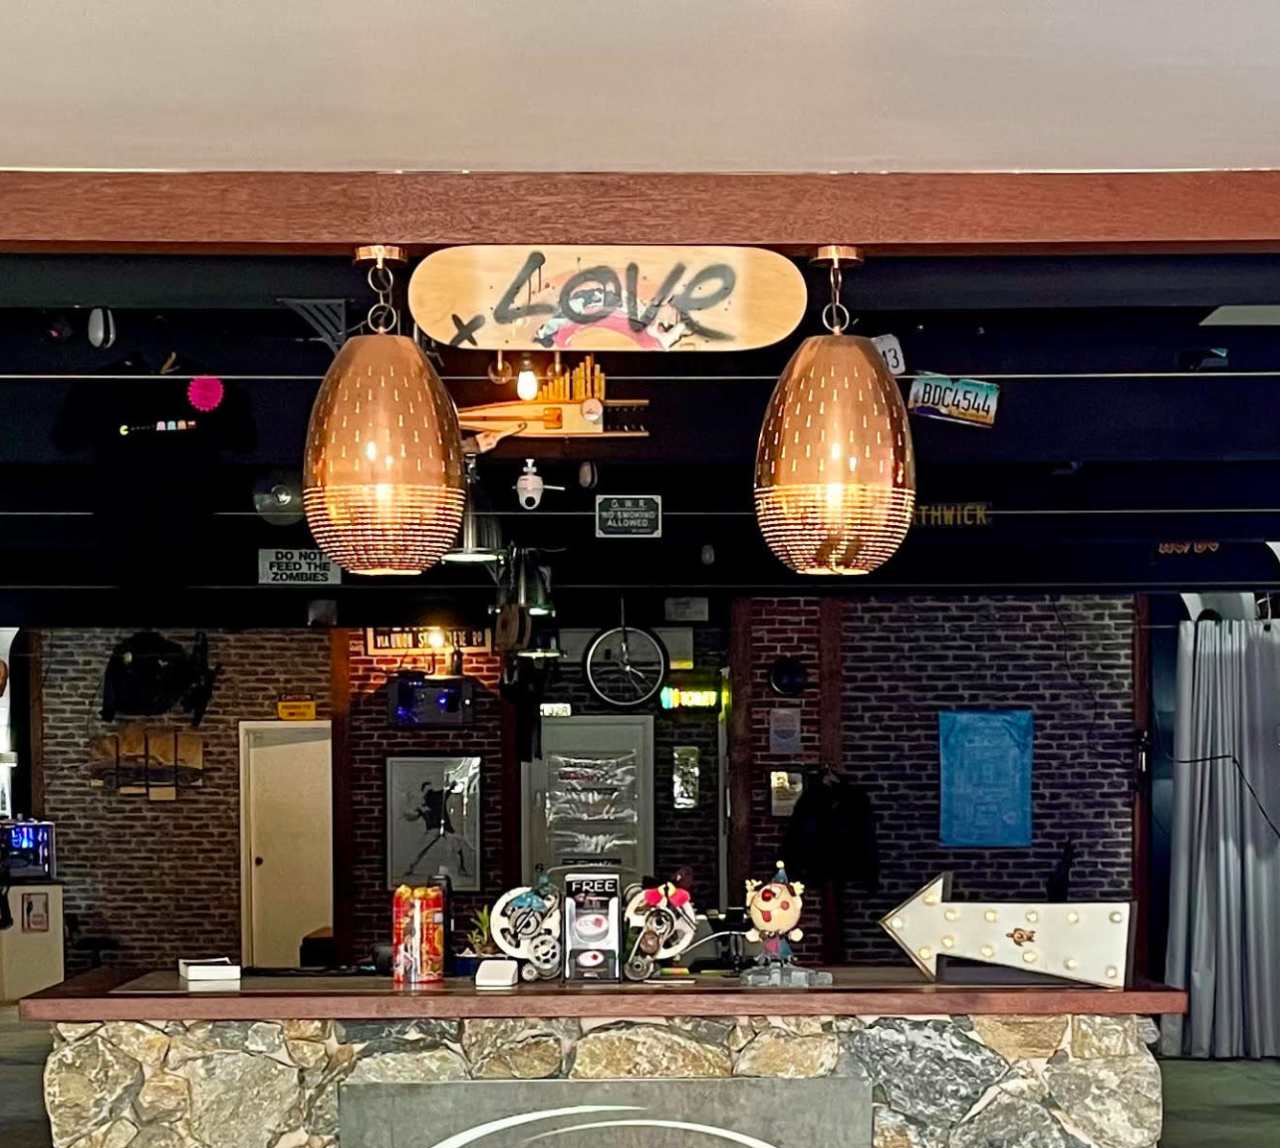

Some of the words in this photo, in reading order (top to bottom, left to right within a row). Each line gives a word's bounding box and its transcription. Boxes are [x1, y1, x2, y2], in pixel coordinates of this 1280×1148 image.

[922, 383, 991, 416] BDC4544
[275, 551, 294, 560] DO
[298, 551, 324, 560] NOT
[269, 562, 302, 571] FEED
[306, 562, 331, 572] THE
[271, 572, 329, 582] ZOMBIES
[572, 880, 616, 892] FREE
